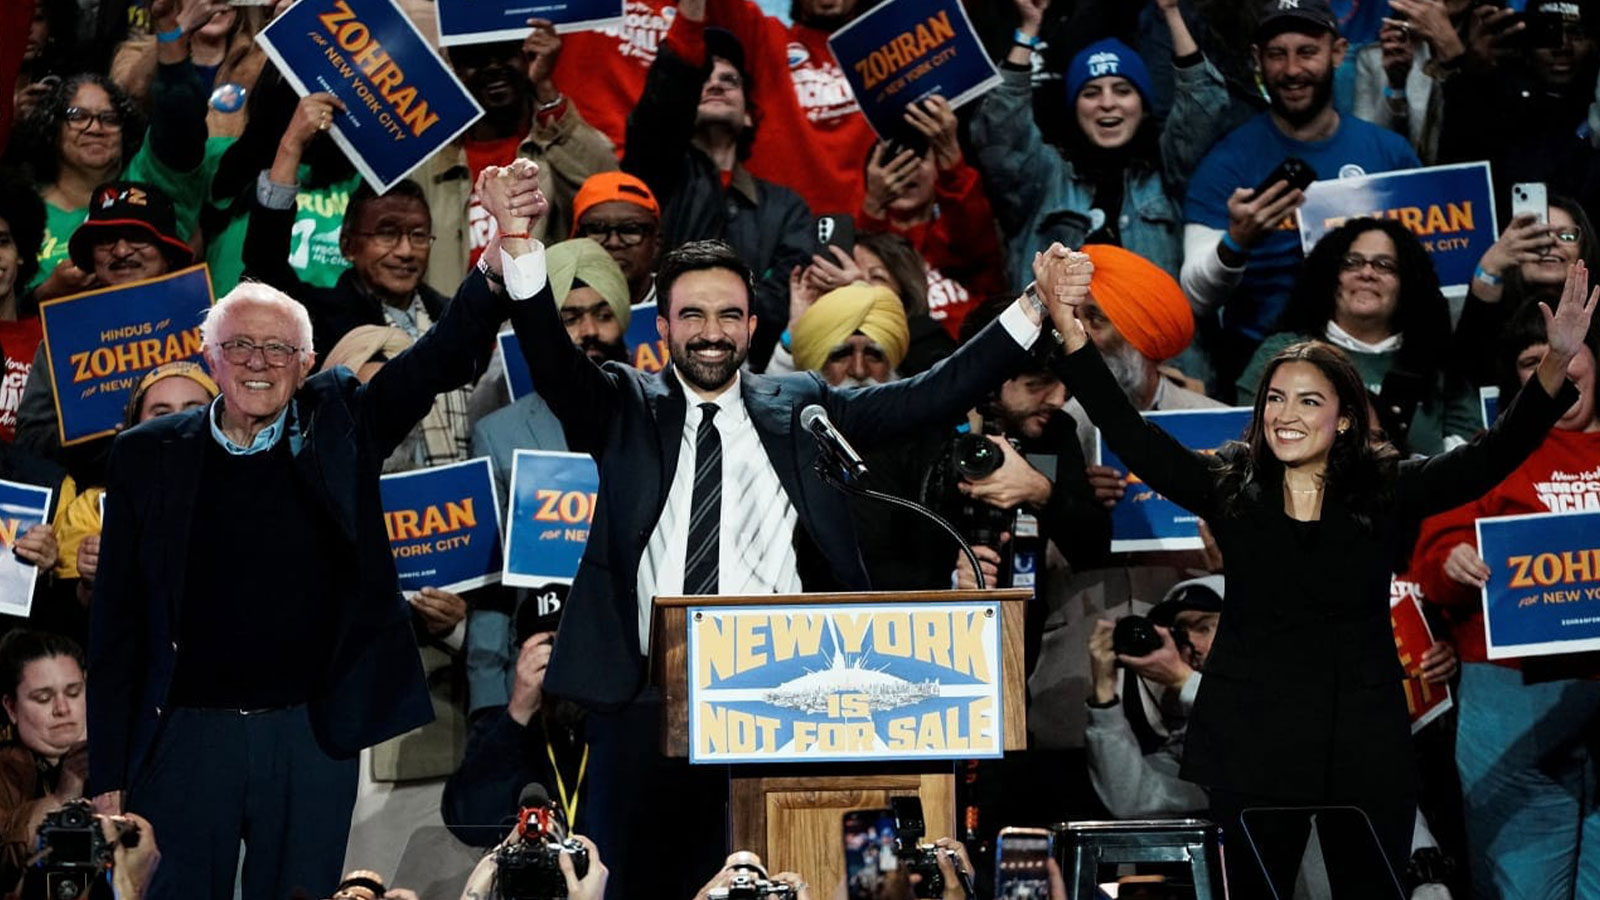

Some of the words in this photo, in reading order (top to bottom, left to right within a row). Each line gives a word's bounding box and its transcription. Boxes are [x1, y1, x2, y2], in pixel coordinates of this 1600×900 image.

[855, 9, 956, 90] ZOHRAN
[318, 0, 440, 138] ZOHRAN
[1089, 63, 1119, 76] UFT
[324, 46, 354, 78] NEW
[352, 78, 382, 114] YORK
[379, 112, 406, 141] CITY
[1437, 237, 1469, 252] CITY
[101, 322, 152, 342] HINDUS
[70, 326, 205, 383] ZOHRAN
[100, 377, 133, 393] NEW
[435, 534, 471, 552] CITY
[1543, 590, 1581, 604] NEW
[699, 612, 825, 689] NEW
[832, 610, 991, 684] YORK
[827, 694, 871, 718] IS
[700, 701, 783, 755] NOT
[793, 721, 877, 751] FOR
[887, 697, 994, 750] SALE
